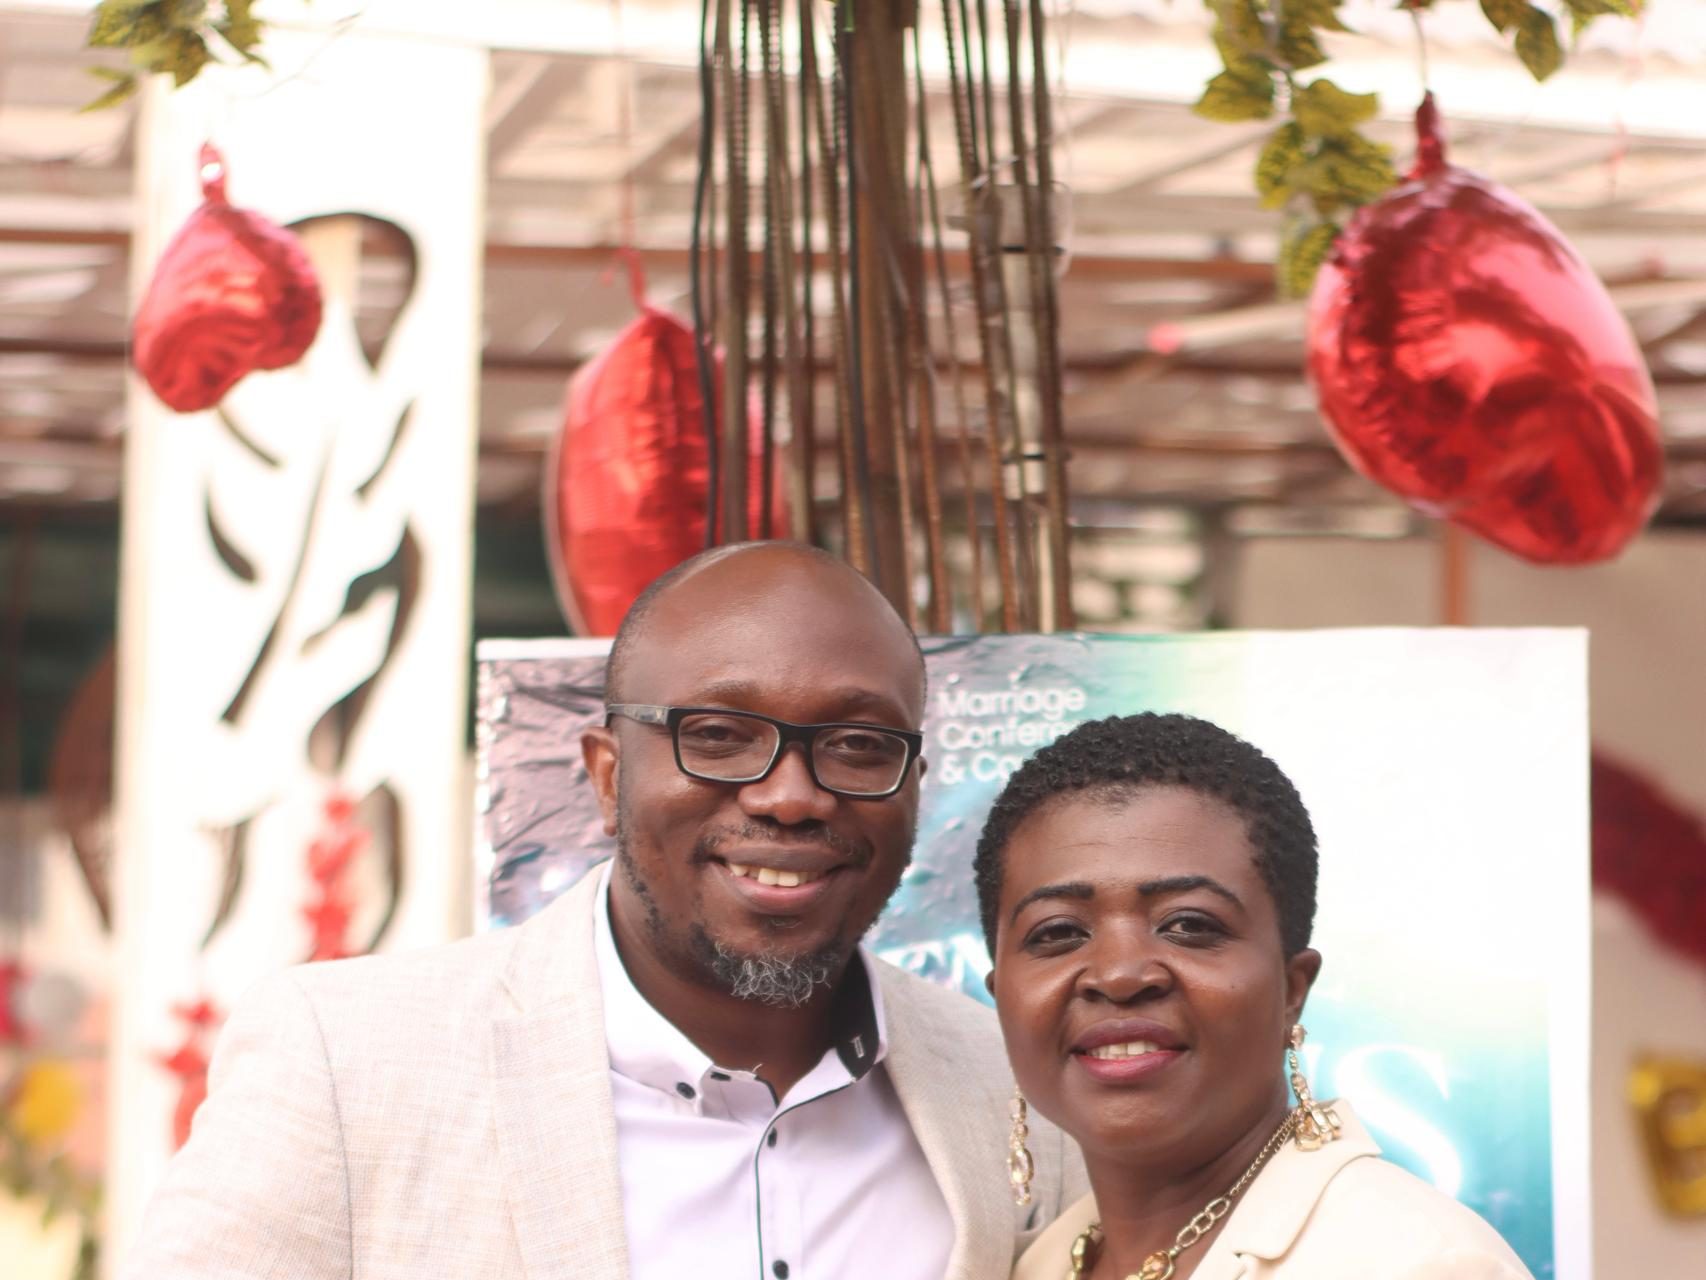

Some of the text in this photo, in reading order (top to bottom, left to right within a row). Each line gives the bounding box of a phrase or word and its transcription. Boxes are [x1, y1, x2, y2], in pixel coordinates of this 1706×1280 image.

[937, 685, 1087, 720] Marriage
[938, 717, 1076, 750] Confere
[939, 754, 966, 785] &
